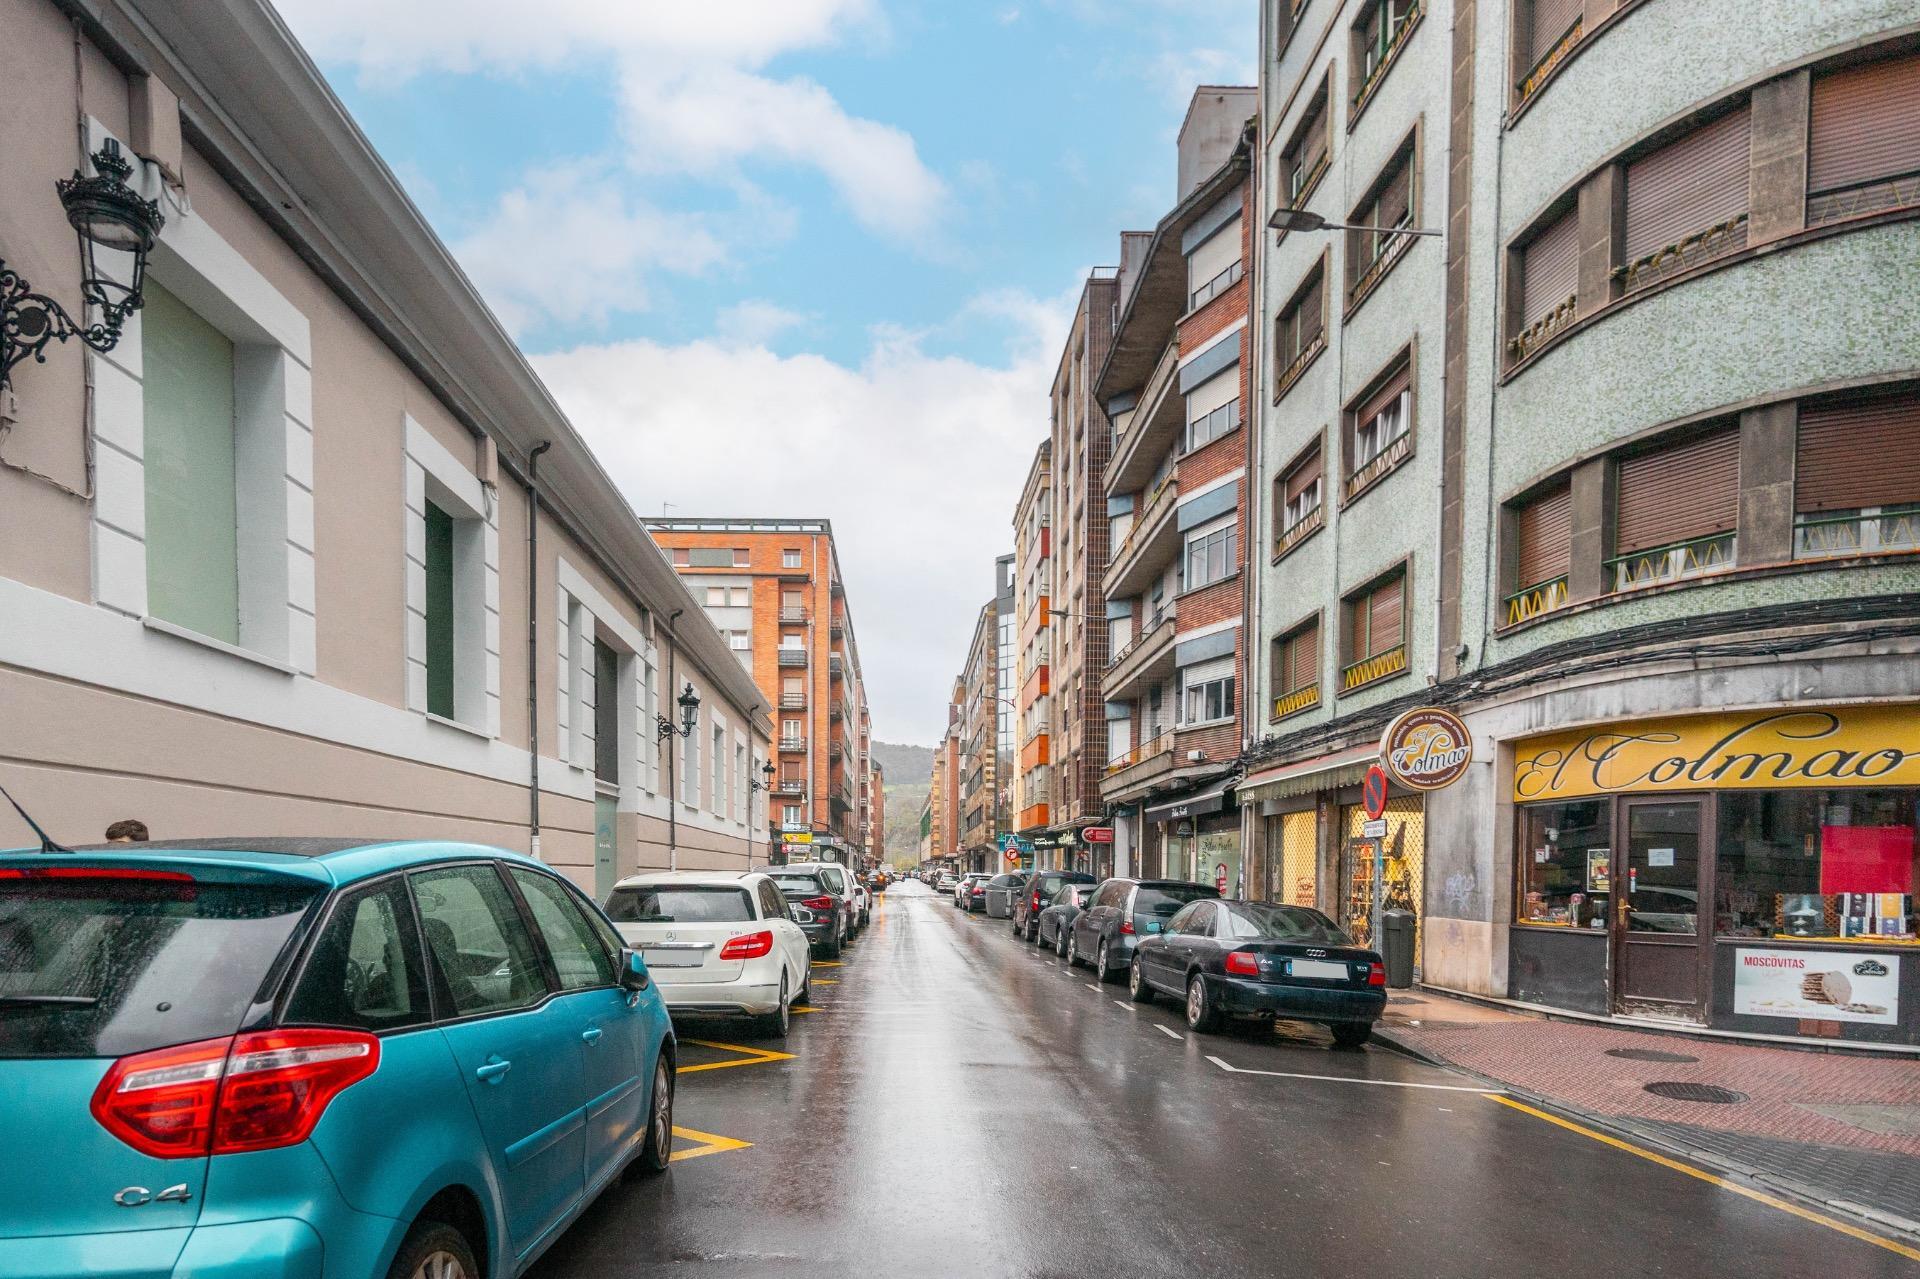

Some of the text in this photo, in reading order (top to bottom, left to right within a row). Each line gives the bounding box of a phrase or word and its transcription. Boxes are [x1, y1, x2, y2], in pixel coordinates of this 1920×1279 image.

[1392, 732, 1470, 776] Colmao
[1516, 710, 1920, 798] El Colmao
[1744, 956, 1805, 969] MOSCOVITAS
[114, 1182, 192, 1207] C4
